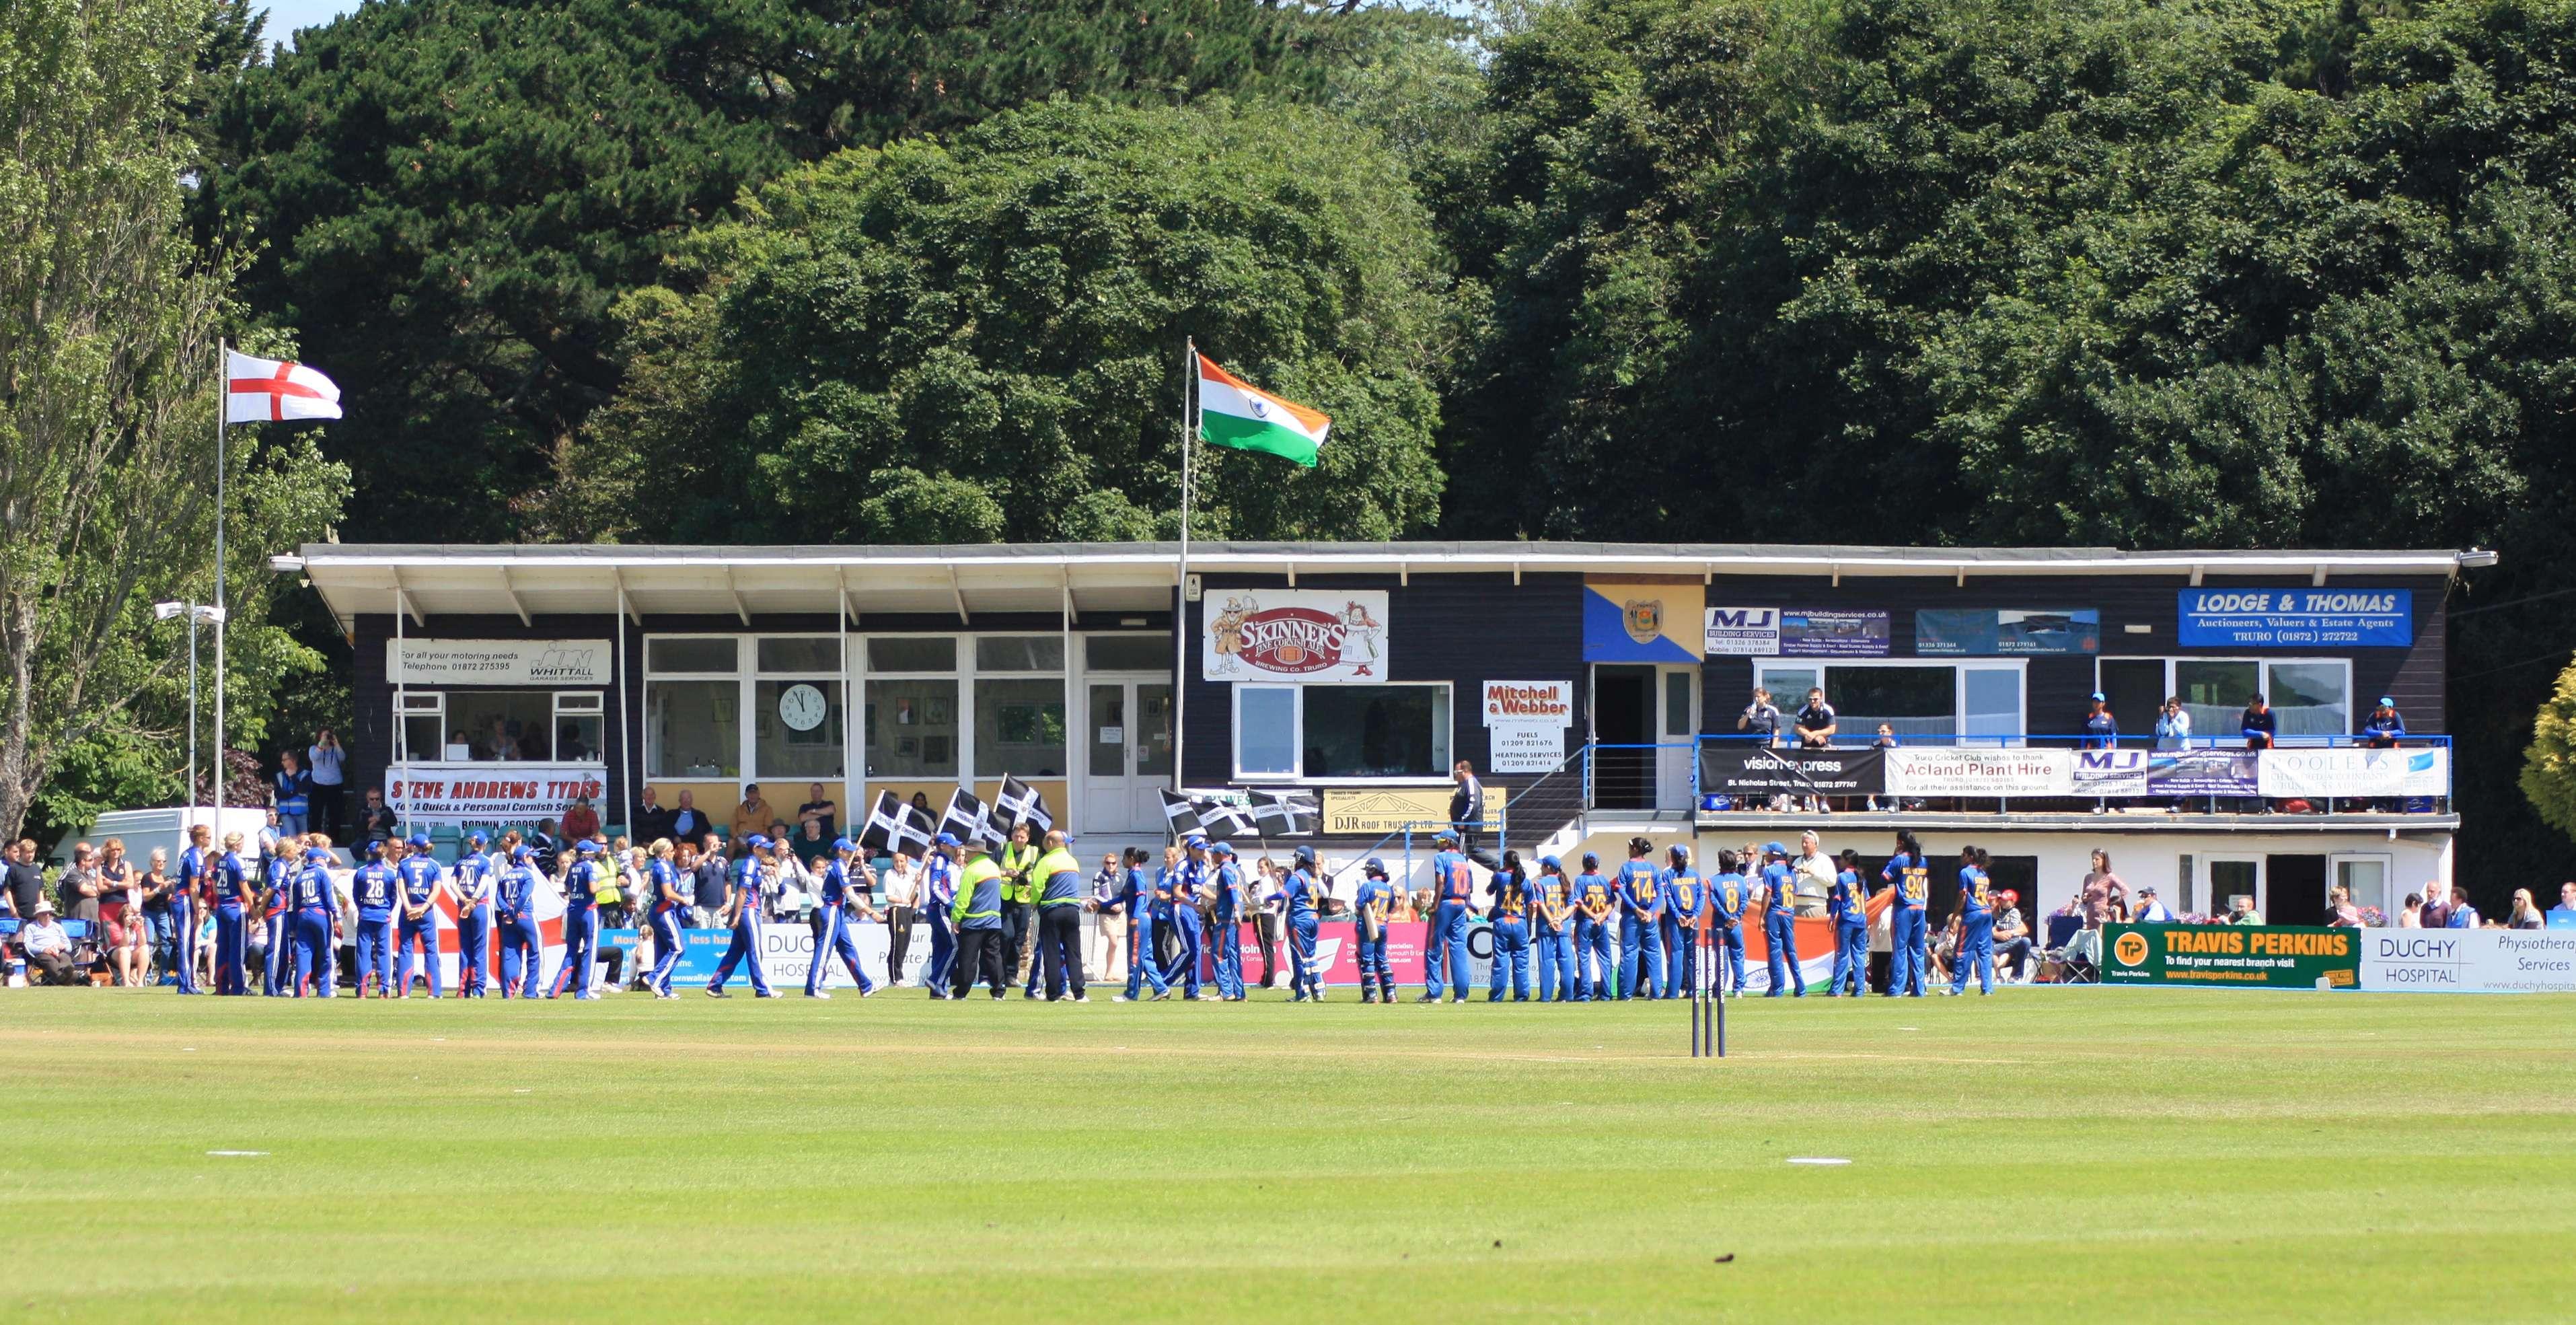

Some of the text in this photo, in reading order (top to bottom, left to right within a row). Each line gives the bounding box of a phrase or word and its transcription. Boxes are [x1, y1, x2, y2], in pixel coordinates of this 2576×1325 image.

[2196, 594, 2395, 612] LODGE & THOMAS
[1711, 610, 1775, 628] MJ
[2197, 618, 2394, 629] Auctioneers, Valuers & Estate Agents
[1241, 620, 1346, 651] SKINNER'S
[2234, 633, 2272, 641] TRURO
[2322, 632, 2358, 641] 272722
[1256, 640, 1274, 654] FINE
[1307, 640, 1325, 655] ALES
[429, 653, 449, 661] your
[451, 653, 490, 661] motoring
[404, 662, 447, 671] Telephone
[479, 662, 510, 670] 275395
[1255, 660, 1288, 672] BREWING
[1304, 662, 1327, 672] TRURO
[1487, 686, 1558, 701] Mitchell
[1489, 699, 1569, 716] & Webber
[1744, 756, 1783, 771] vision
[1905, 762, 2052, 776] Acland Plant Hire
[2079, 752, 2142, 769] MJ
[391, 781, 602, 799] STEVE ANDREWS TYRES
[414, 803, 420, 811] A
[422, 802, 451, 812] Quick
[453, 803, 460, 812] &
[463, 802, 510, 812] Personal
[512, 802, 552, 812] Cornish
[1335, 816, 1360, 830] DJR
[1362, 822, 1380, 830] ROOF
[901, 826, 922, 839] CRICKET
[217, 868, 228, 887] 29
[414, 868, 424, 887] 5
[459, 865, 475, 885] 20
[1452, 869, 1469, 895] 10
[301, 879, 316, 898] 10
[366, 879, 384, 898] 28
[1632, 878, 1655, 903] 14
[1780, 884, 1794, 908] 16
[1679, 885, 1693, 910] 9
[1726, 888, 1738, 914] 8
[690, 934, 711, 945] less
[2164, 931, 2349, 956] TRAVIS PERKINS
[2380, 938, 2456, 958] DUCHY
[2498, 935, 2576, 955] Physiothera
[2121, 941, 2143, 958] TP
[2164, 956, 2295, 968] To find your nearest branch visit
[2517, 958, 2571, 970] Services
[2166, 970, 2268, 982] www.travisperkins.co.uk
[2386, 968, 2456, 983] HOSPITAL
